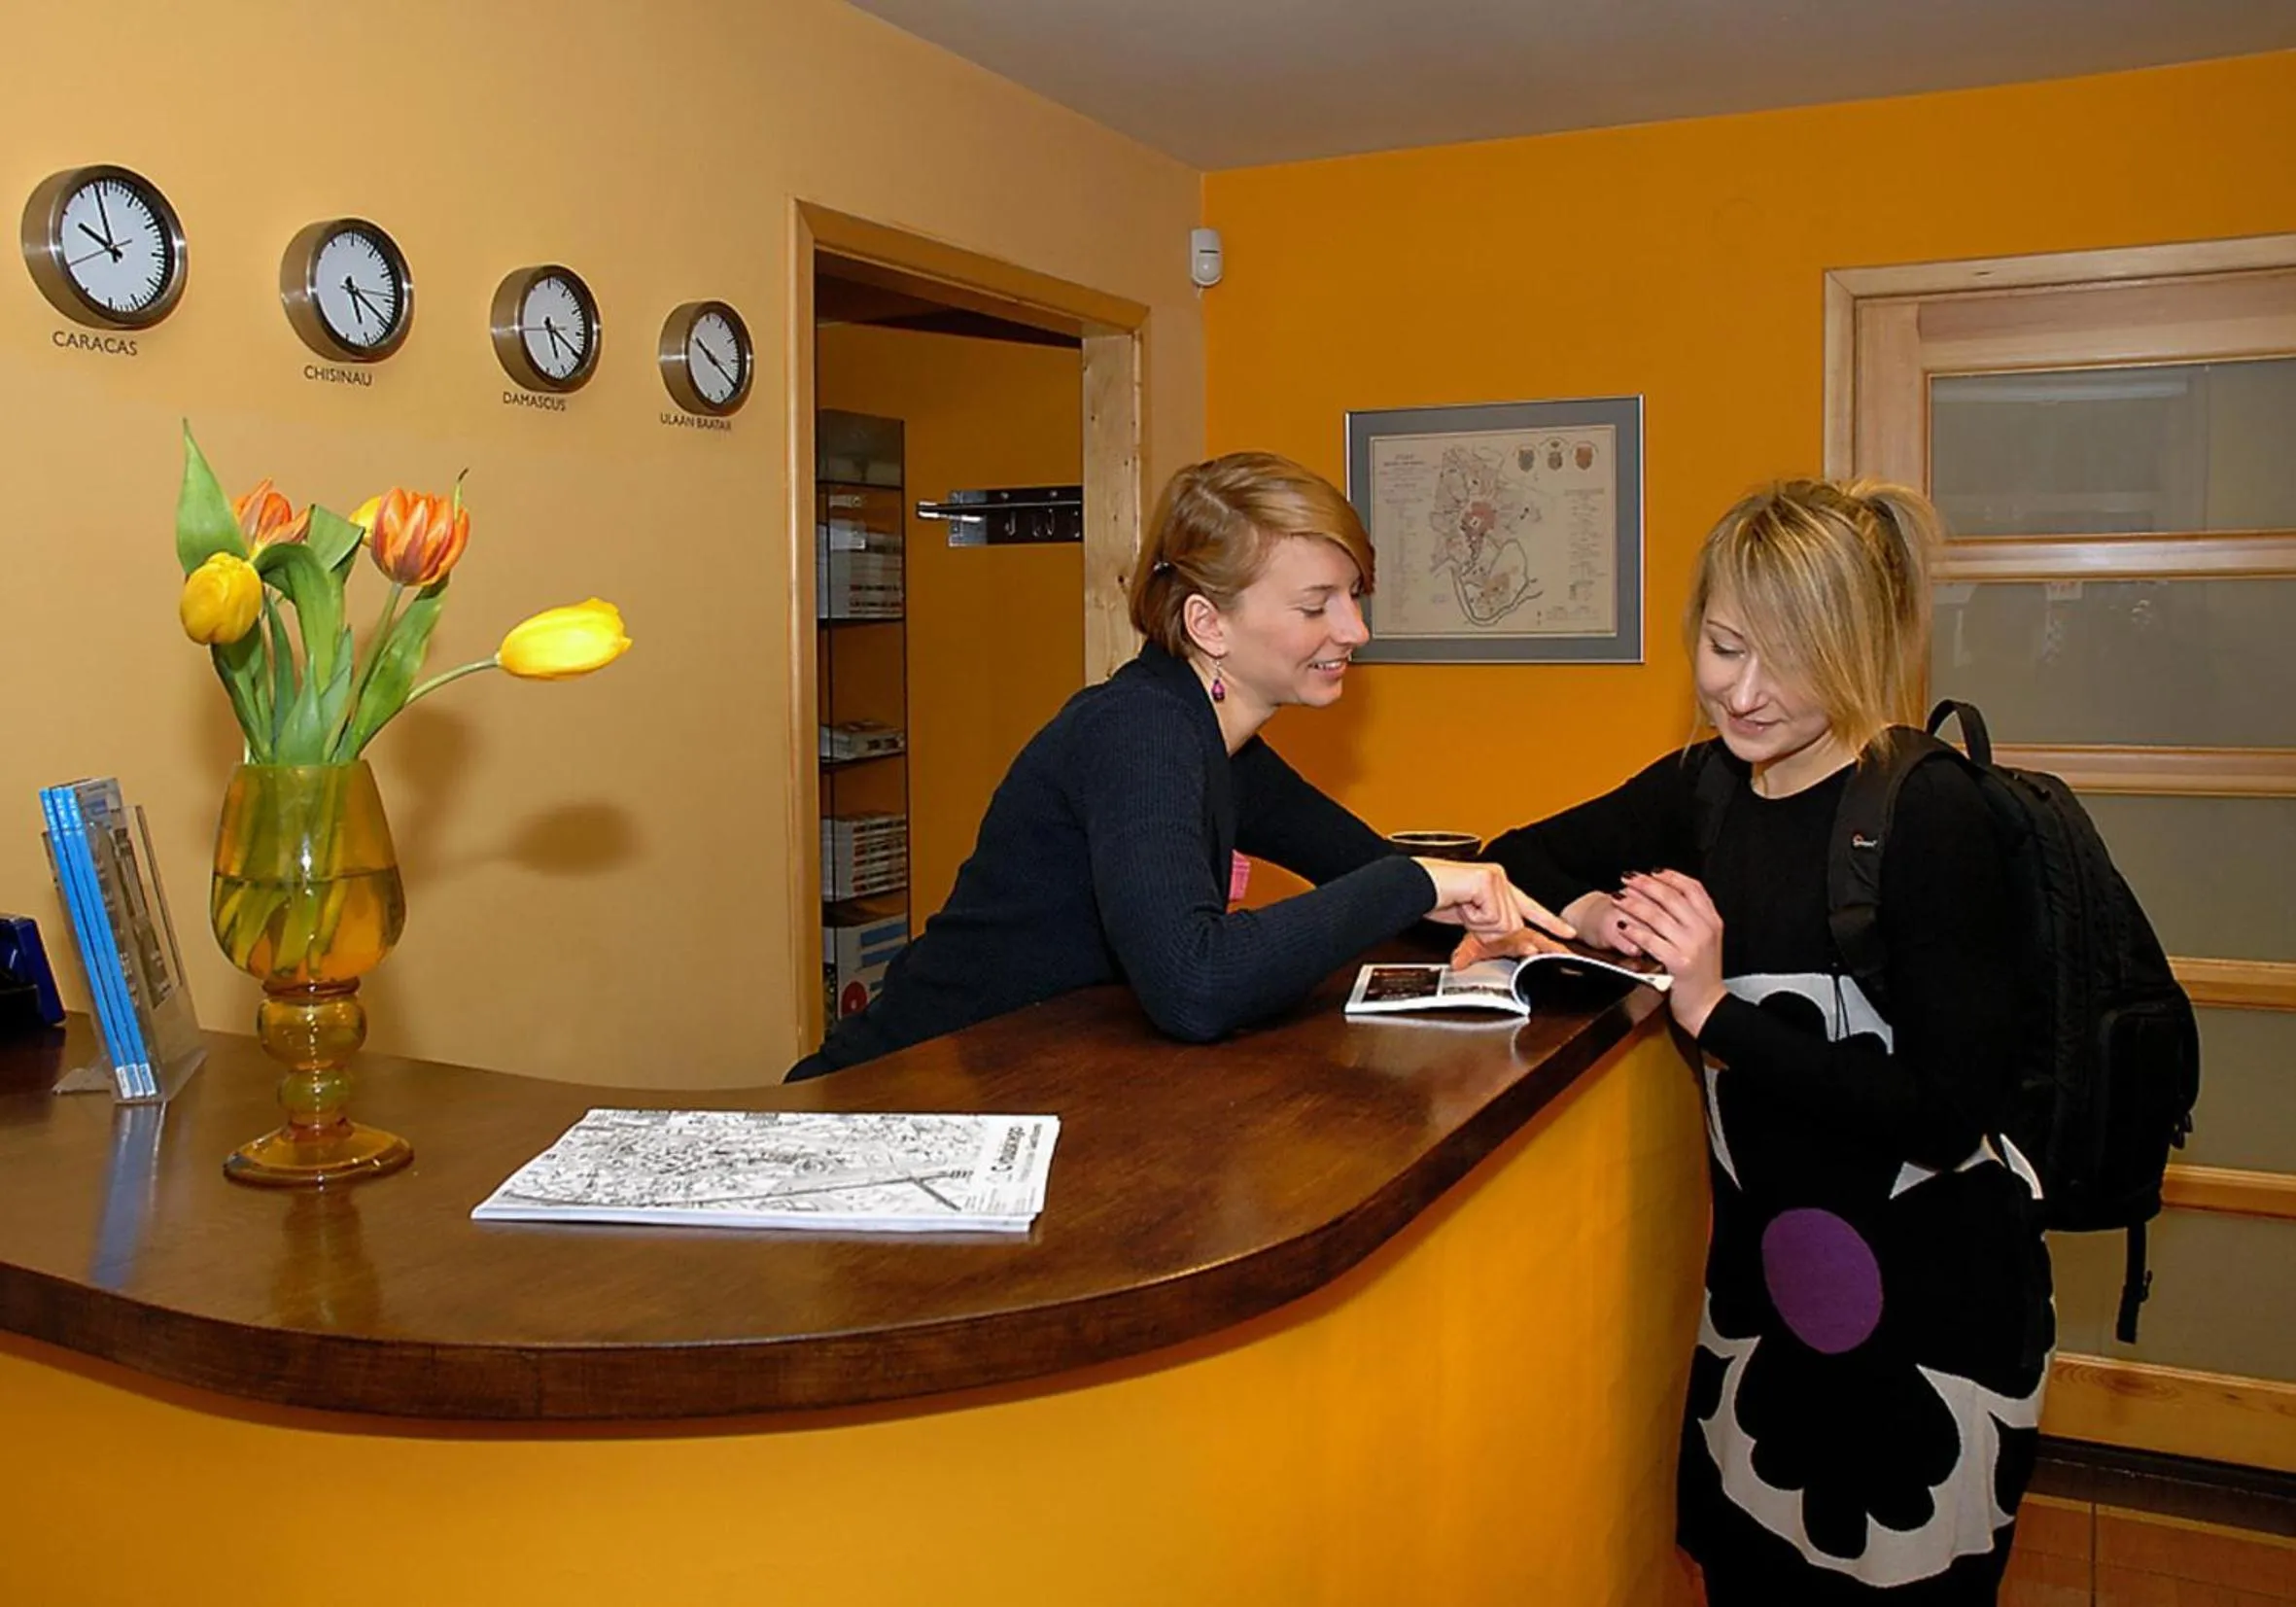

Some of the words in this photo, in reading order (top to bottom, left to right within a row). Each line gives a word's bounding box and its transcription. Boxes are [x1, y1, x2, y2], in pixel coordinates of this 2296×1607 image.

[52, 331, 138, 356] CARACAS
[303, 365, 372, 386] CHISINAU
[503, 391, 566, 411] DAMASCUS
[660, 412, 694, 427] ULAAN
[697, 417, 732, 431] BAATAR
